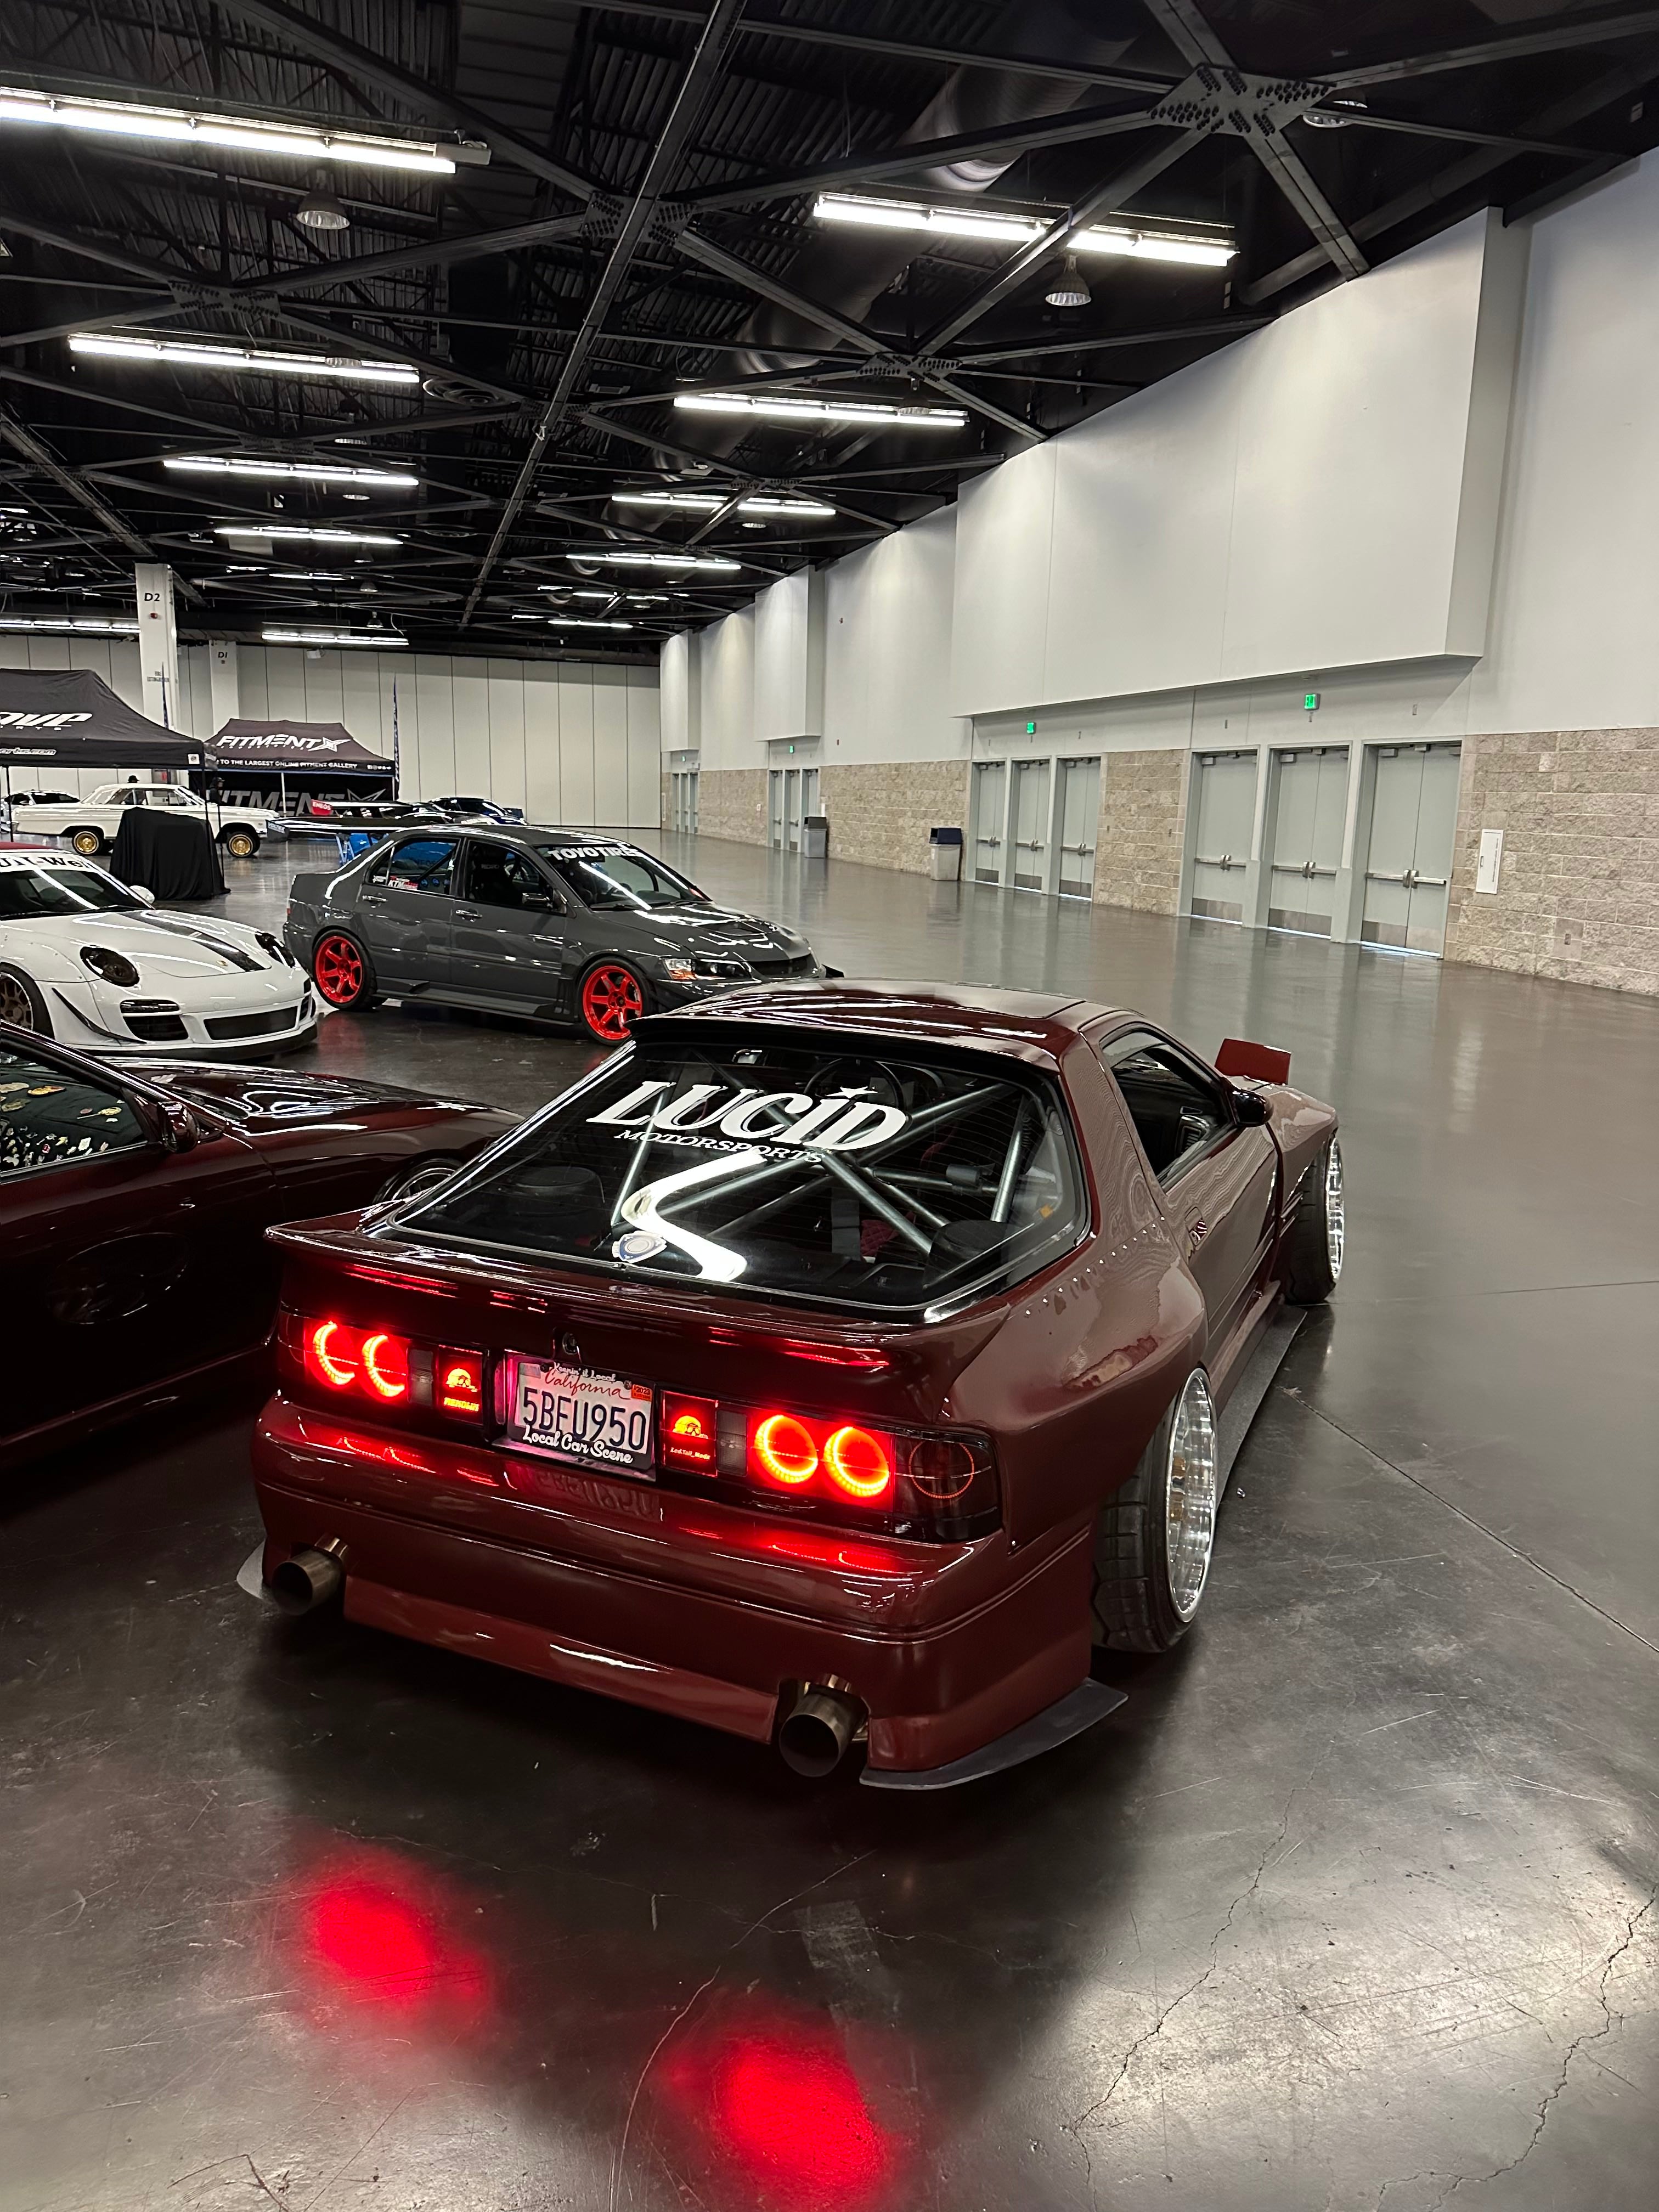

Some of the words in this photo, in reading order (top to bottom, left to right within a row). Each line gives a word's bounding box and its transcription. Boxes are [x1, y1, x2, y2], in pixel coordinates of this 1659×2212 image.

[144, 592, 160, 601] D2
[312, 801, 331, 811] ENEOS
[586, 1081, 912, 1150] LUCID
[614, 1130, 825, 1163] MOTORSPORTS
[545, 1368, 630, 1400] California
[590, 1370, 616, 1382] Local
[636, 1386, 651, 1396] 2023
[523, 1387, 646, 1451] 5BFU950
[523, 1424, 560, 1447] Local
[561, 1432, 589, 1454] Car
[590, 1441, 633, 1464] Scene
